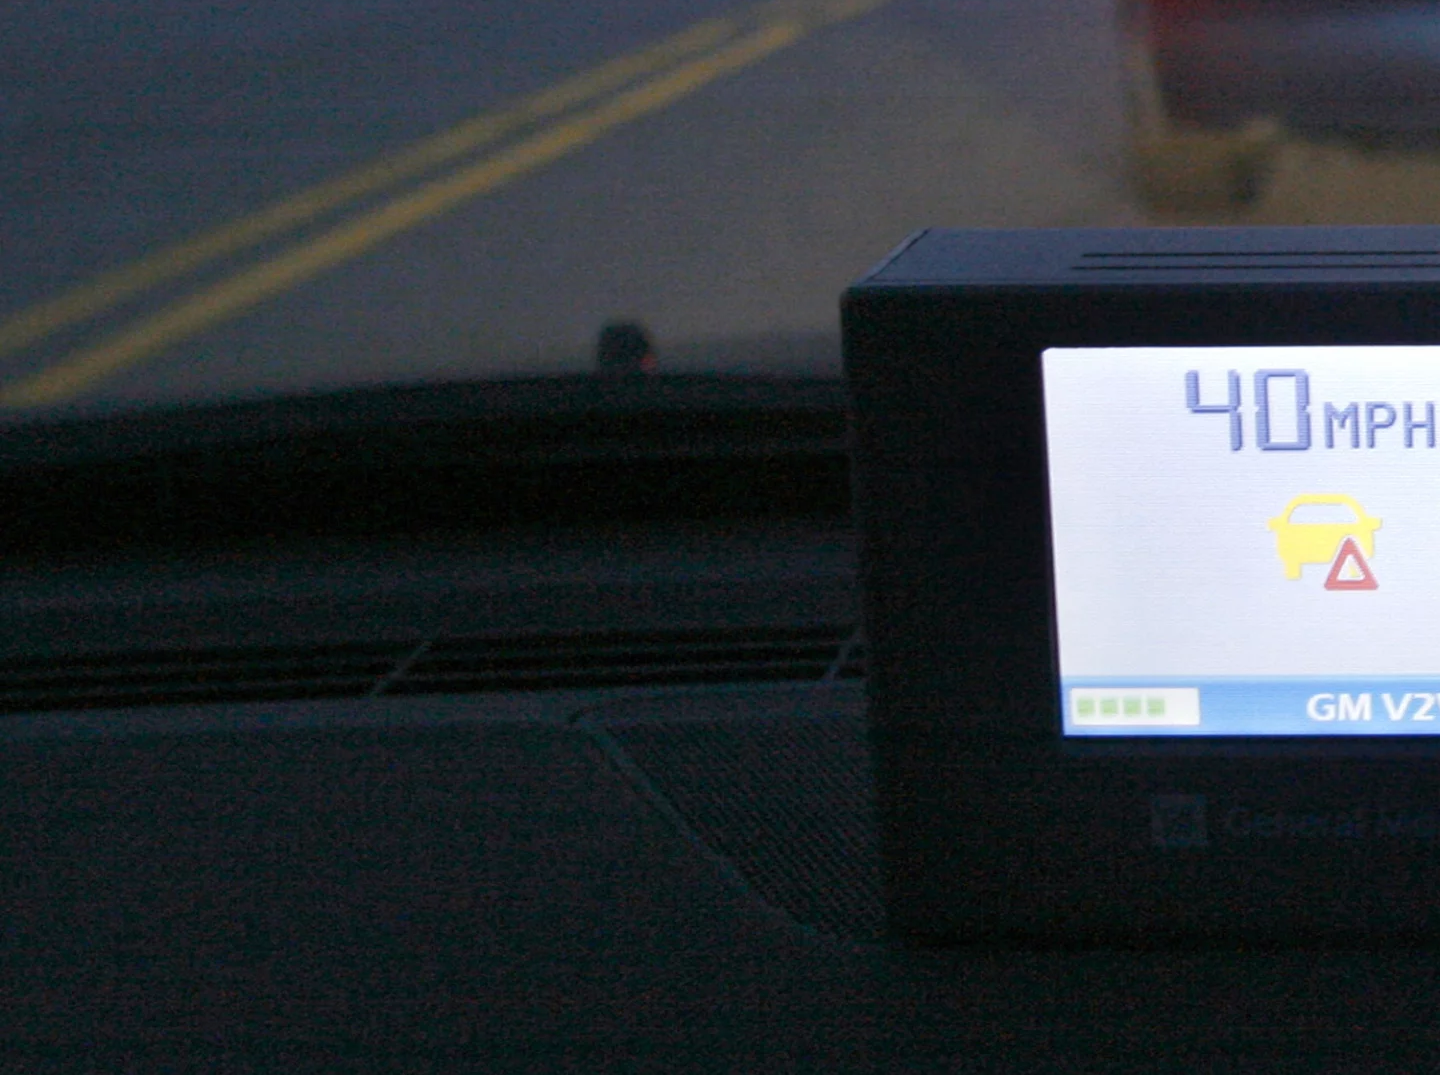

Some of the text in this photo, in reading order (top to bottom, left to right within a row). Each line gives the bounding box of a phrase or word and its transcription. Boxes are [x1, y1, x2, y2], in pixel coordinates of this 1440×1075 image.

[1185, 369, 1436, 451] 40 MPH
[1306, 692, 1372, 722] GM
